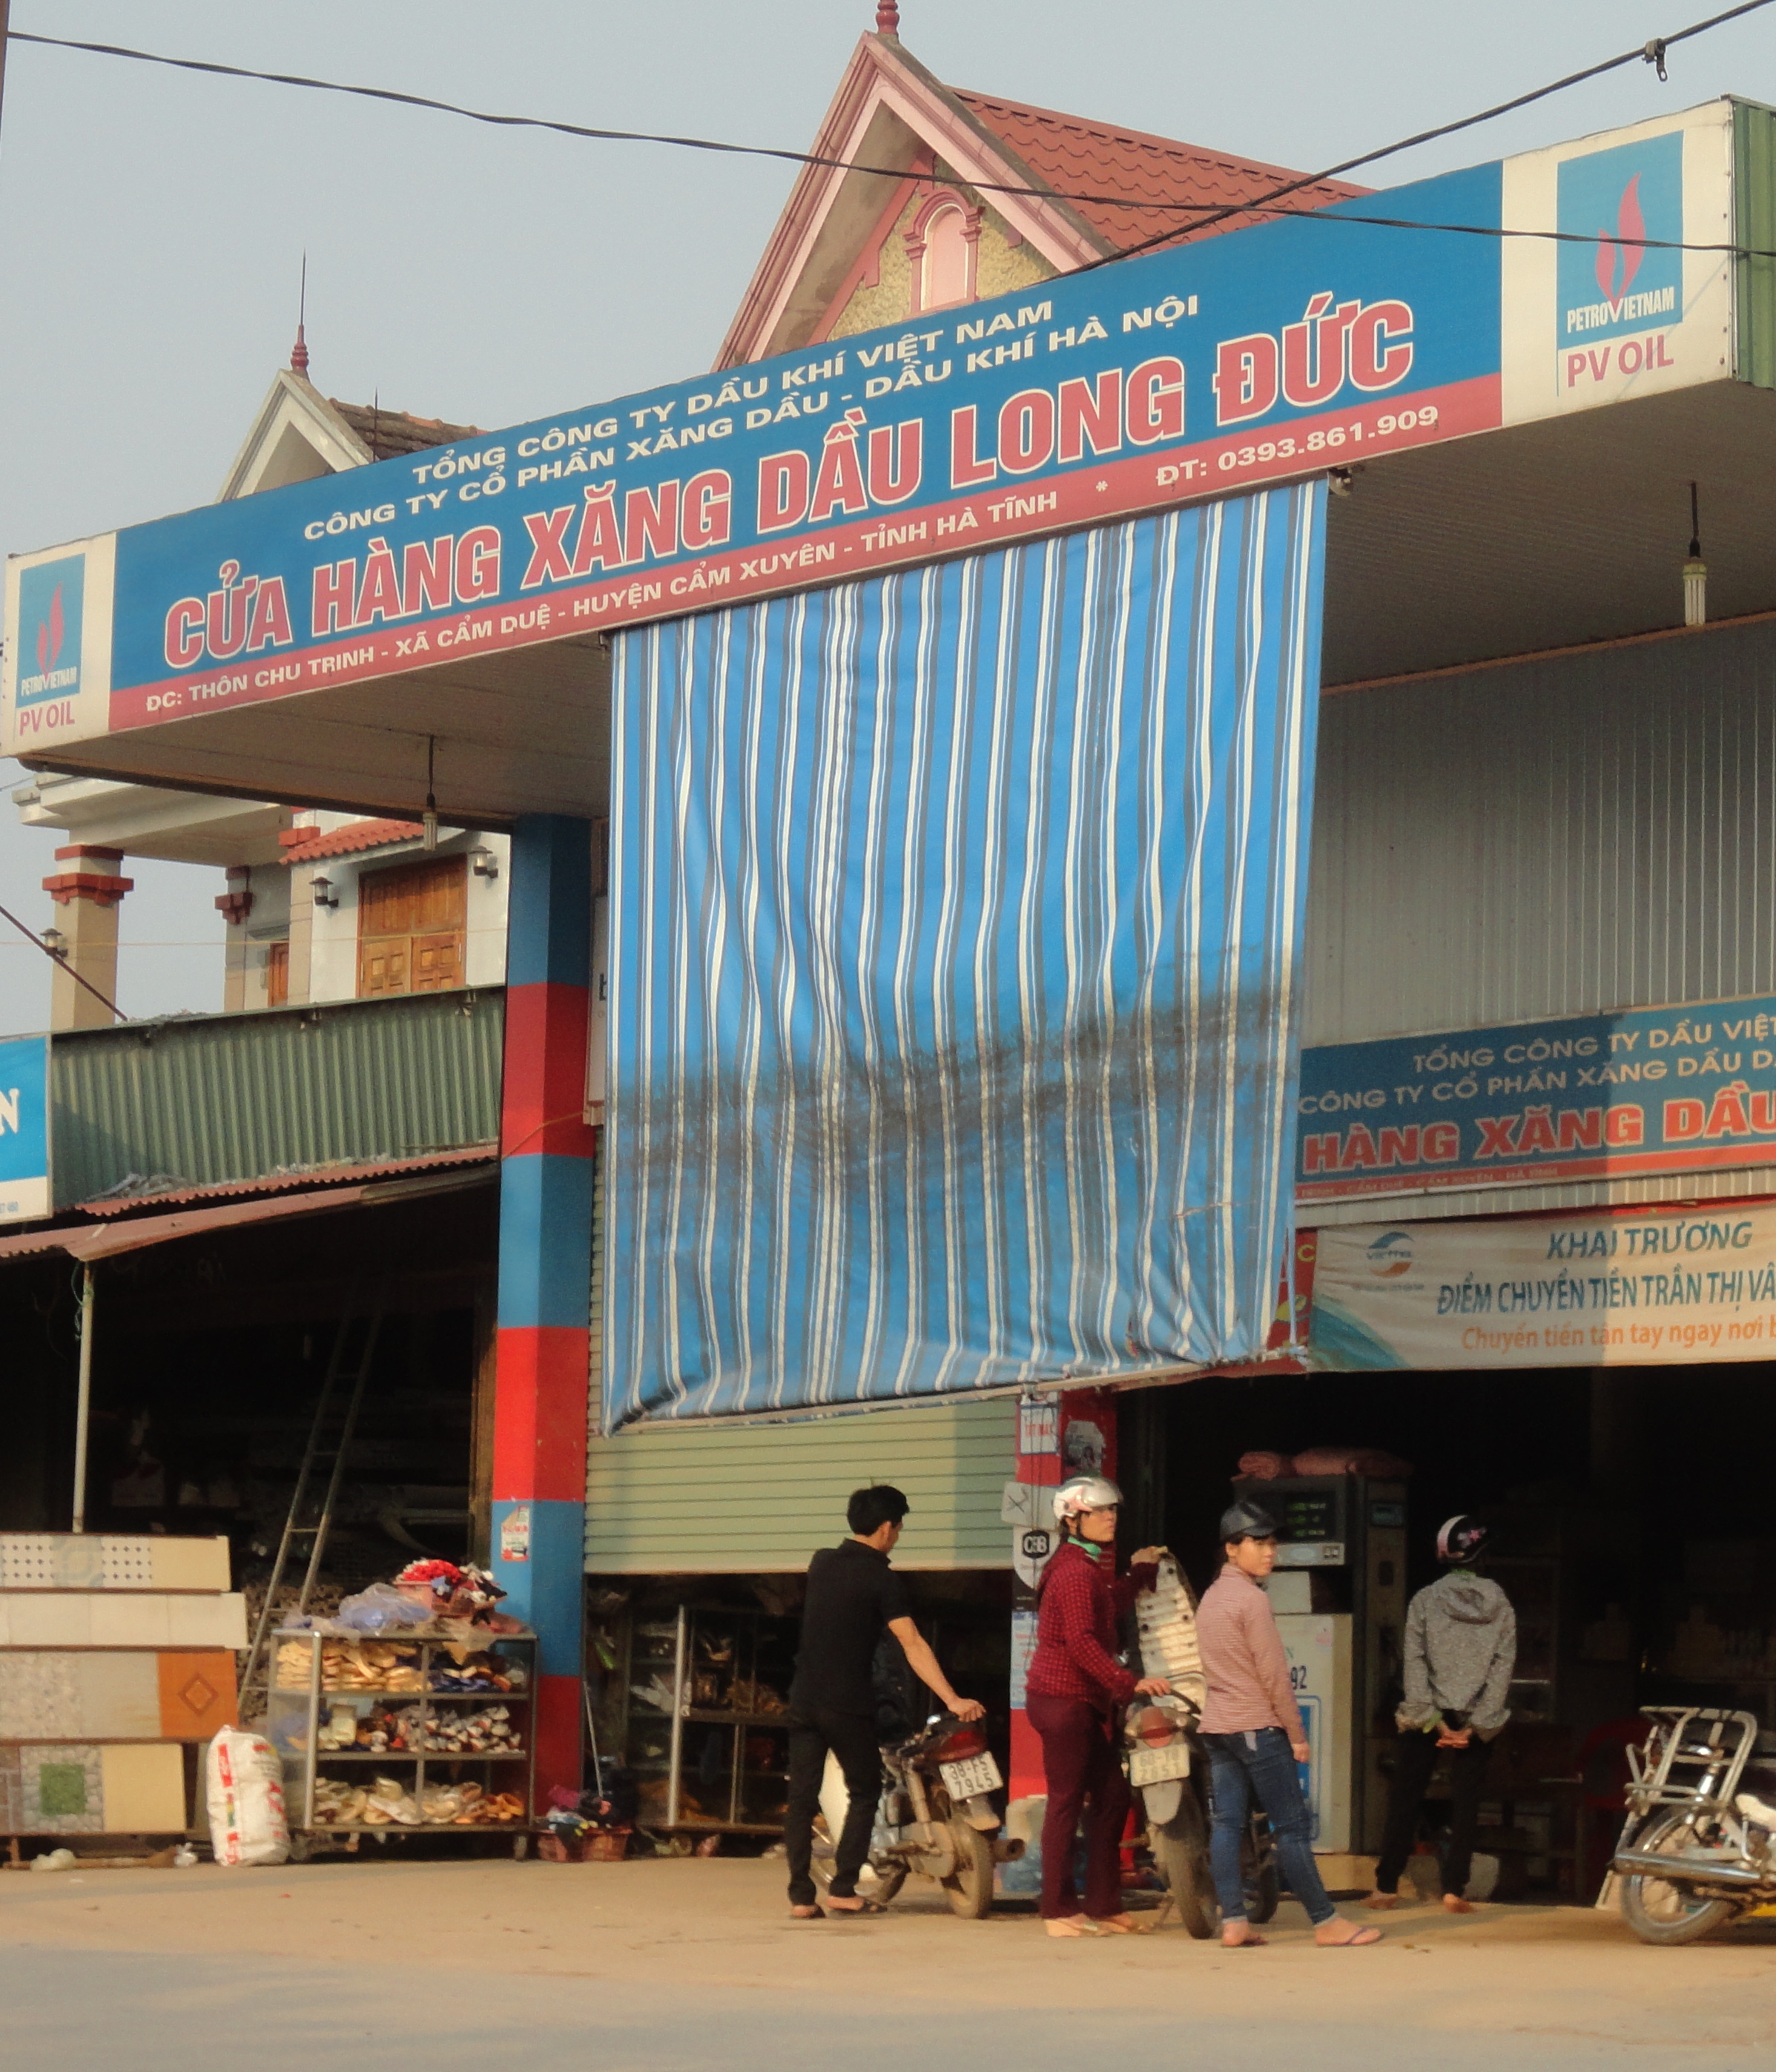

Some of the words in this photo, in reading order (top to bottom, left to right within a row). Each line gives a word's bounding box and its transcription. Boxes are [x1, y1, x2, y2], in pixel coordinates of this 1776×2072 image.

[1567, 286, 1674, 334] PETROVIETNAM
[1568, 346, 1611, 388] PV
[1618, 334, 1674, 375] OIL
[303, 503, 396, 541] CÔNG
[406, 489, 449, 515] TY
[458, 465, 506, 502] CỔ
[518, 446, 615, 488] PHẦN
[626, 418, 733, 462] XĂNG
[745, 391, 829, 430] DẦU
[865, 359, 953, 399] DẦU
[966, 331, 1037, 374] KHÍ
[1049, 316, 1109, 352] HÀ
[1123, 294, 1199, 333] NỘI
[412, 446, 506, 484] TỔNG
[517, 418, 618, 458] CÔNG
[630, 400, 676, 428] TY
[687, 376, 769, 415] DẦU
[782, 350, 847, 389] KHÍ
[857, 330, 945, 369] VIỆT
[955, 300, 1052, 344] NAM
[1155, 458, 1208, 487] ĐT:
[1217, 405, 1439, 472] 0393.861.909
[163, 558, 294, 670] CỬA
[311, 524, 502, 638] HÀNG
[520, 468, 732, 591] XĂNG
[756, 406, 923, 535] DẦU
[950, 355, 1186, 490] LONG
[1212, 290, 1414, 428] ĐỨC
[188, 673, 248, 702] THÔN
[254, 663, 301, 688] CHU
[307, 647, 374, 676] TRINH
[395, 630, 431, 658] XÃ
[437, 615, 492, 648] CẨM
[500, 603, 551, 634] DUỆ
[573, 575, 662, 618] HUYỆN
[669, 561, 730, 595] CẨM
[739, 541, 836, 581] XUYÊN
[860, 522, 927, 552] TỈNH
[937, 507, 979, 536] HÀ
[987, 490, 1057, 524] TĨNH
[19, 707, 43, 736] PV
[46, 701, 75, 728] OIL
[1504, 1036, 1599, 1063] CÔNG
[1608, 1031, 1641, 1052] TY
[1298, 1089, 1387, 1114] CÔNG
[1394, 1084, 1424, 1105] TY
[1577, 1060, 1668, 1086] XĂNG
[1752, 1049, 1776, 1070] D
[1302, 1121, 1460, 1175] HÀNG
[1472, 1102, 1645, 1161] XĂNG
[1663, 1079, 1776, 1142] DẦU
[1546, 1230, 1618, 1259] KHAI
[1624, 1220, 1753, 1256] TRƯƠNG
[1706, 1270, 1743, 1313] THỊ
[1631, 1323, 1663, 1350] tay
[1669, 1322, 1723, 1348] ngay
[1728, 1314, 1764, 1340] nơi
